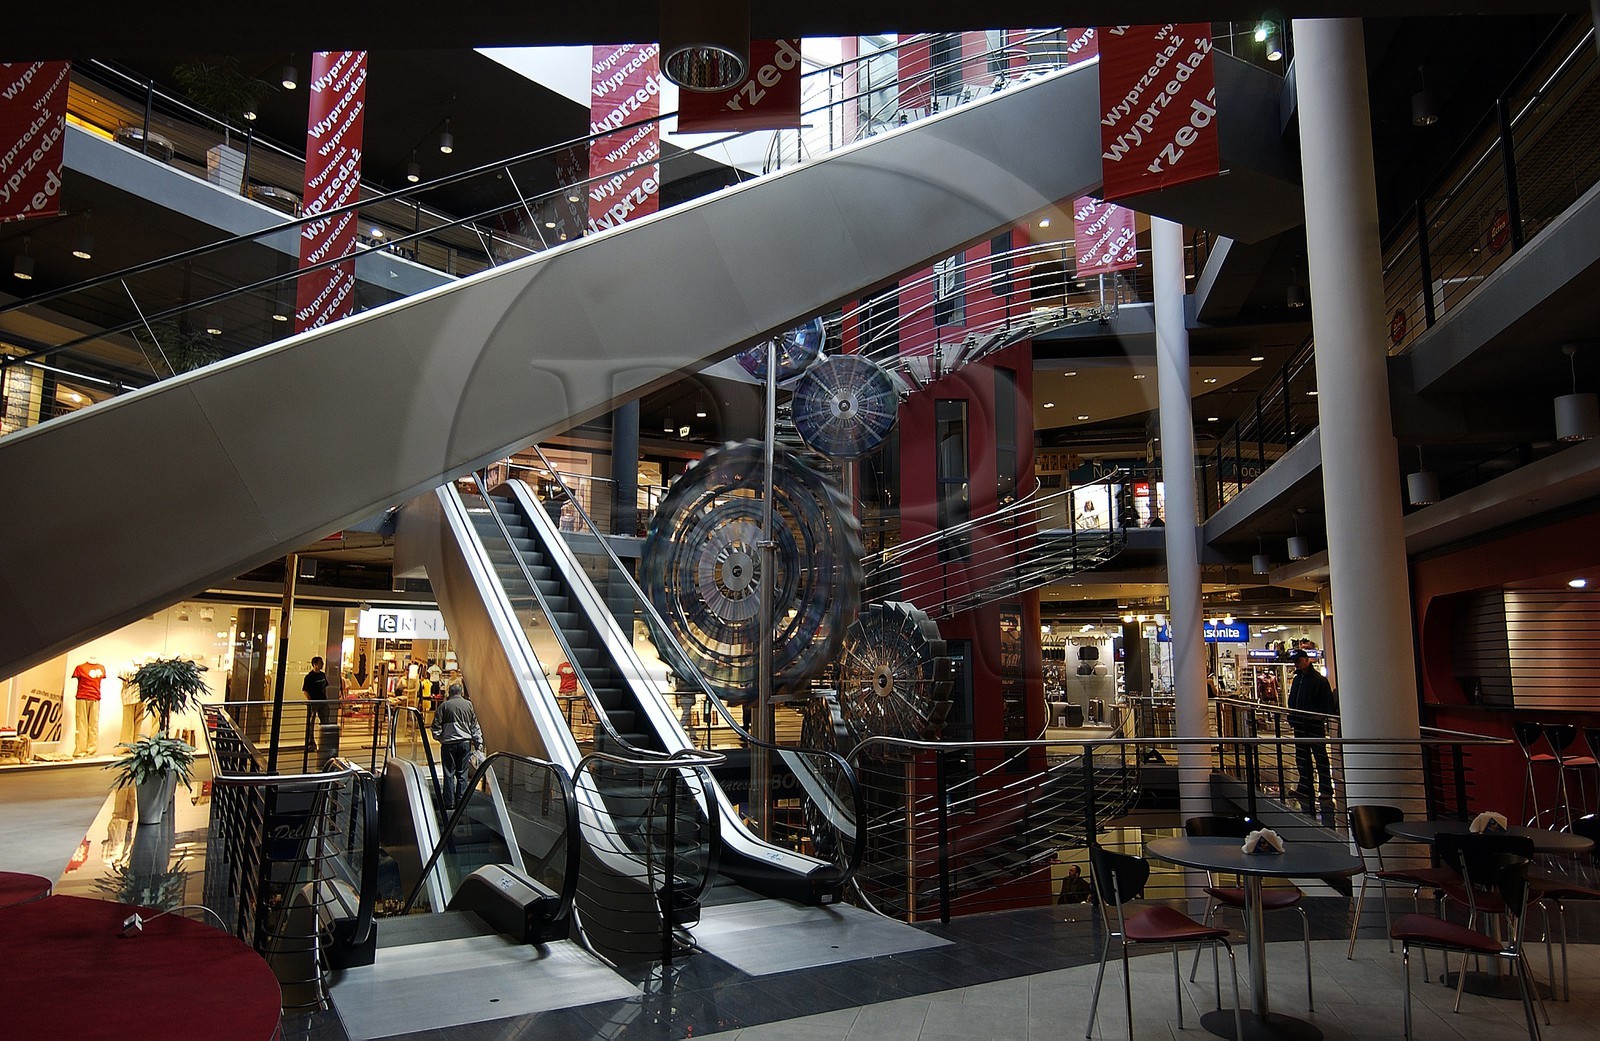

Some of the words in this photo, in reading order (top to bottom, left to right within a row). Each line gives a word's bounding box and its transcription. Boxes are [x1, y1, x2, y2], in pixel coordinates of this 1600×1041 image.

[308, 68, 367, 139] Wyprzedaż
[1101, 35, 1184, 127] Wyprzedaż
[1102, 38, 1213, 162] Wyprzedaż
[318, 100, 364, 156] Wyprzedaż
[296, 268, 345, 321] Wyprzedaż
[1203, 627, 1240, 638] sonite
[17, 696, 62, 742] 50%
